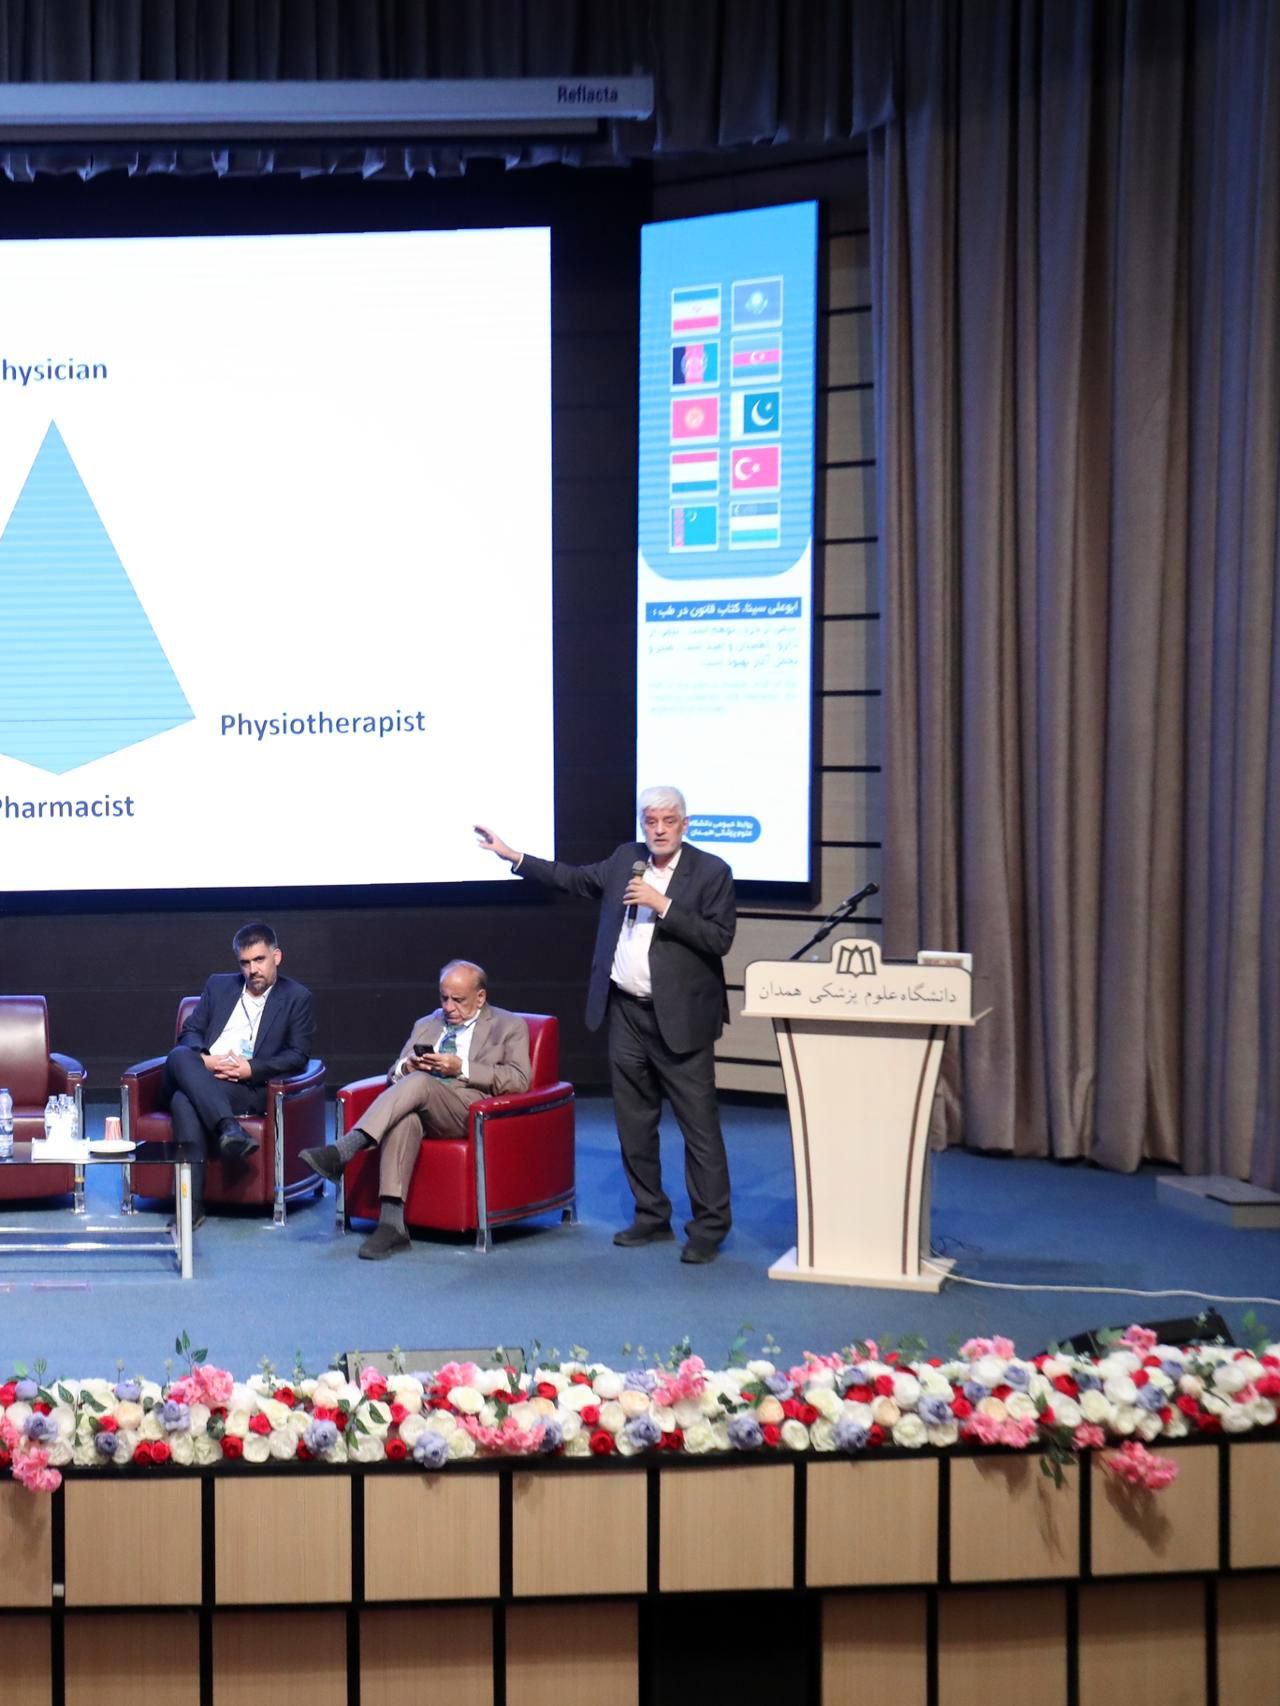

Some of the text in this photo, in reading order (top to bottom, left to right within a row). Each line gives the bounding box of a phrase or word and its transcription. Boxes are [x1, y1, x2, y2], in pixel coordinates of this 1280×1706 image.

[658, 604, 675, 617] طب
[676, 606, 689, 618] در
[690, 603, 716, 617] قانون
[717, 602, 741, 616] کتاب
[222, 710, 425, 741] Physiotherapist
[759, 981, 957, 1006] دانشگاه علوم پزشکی همدان
